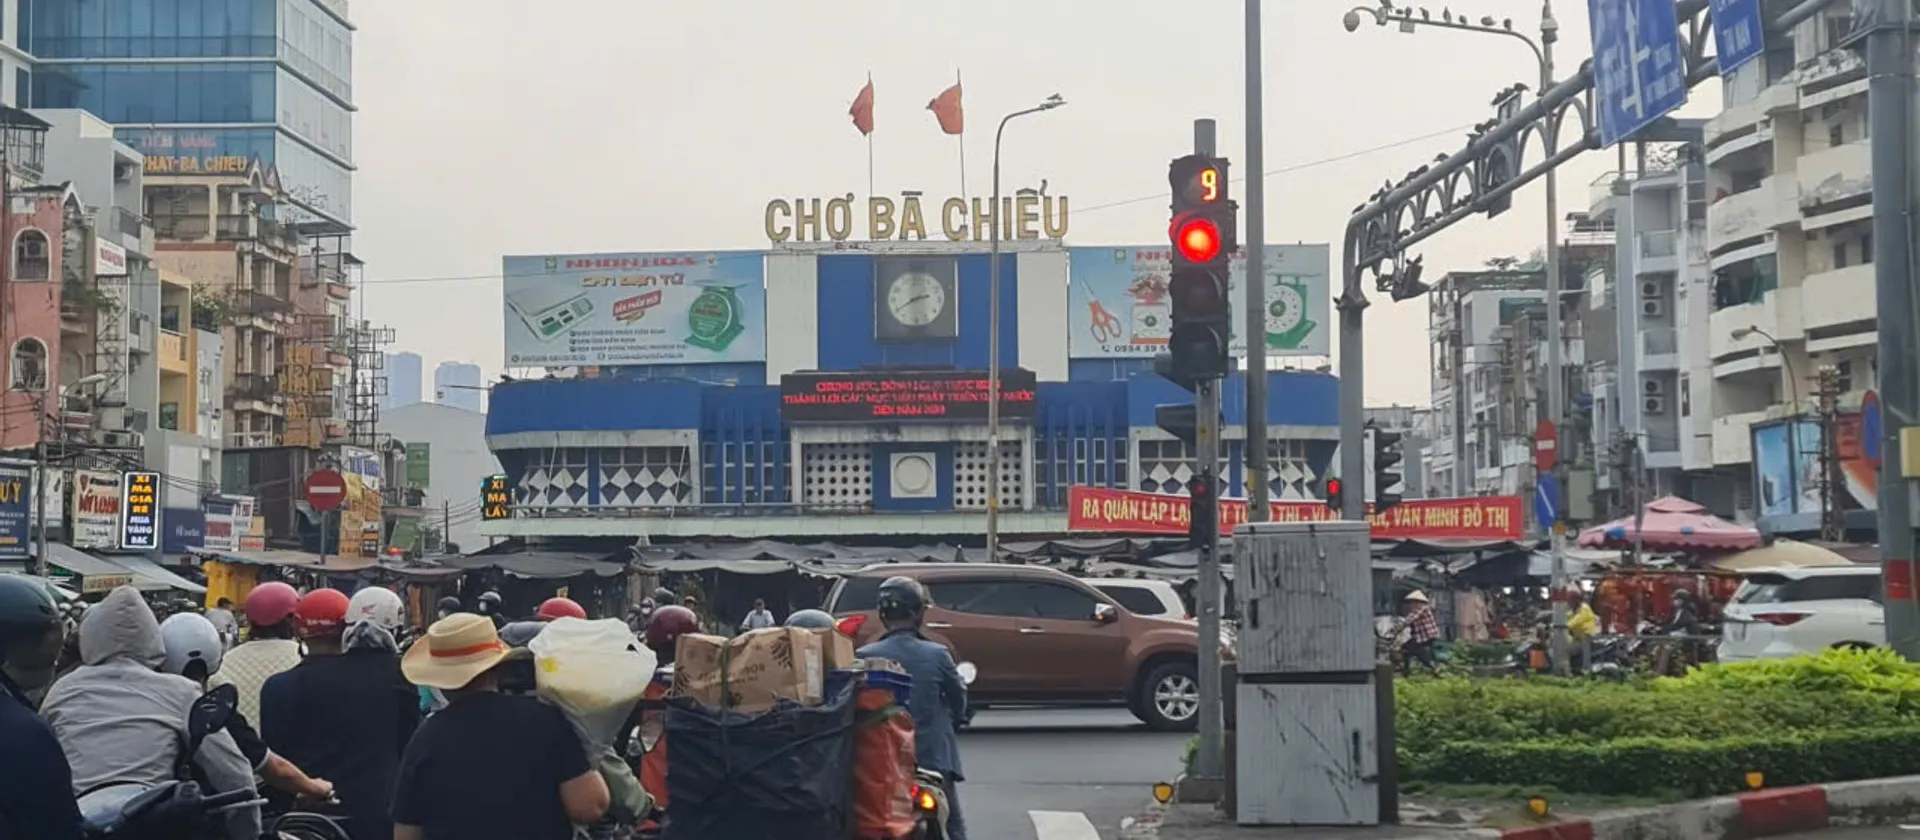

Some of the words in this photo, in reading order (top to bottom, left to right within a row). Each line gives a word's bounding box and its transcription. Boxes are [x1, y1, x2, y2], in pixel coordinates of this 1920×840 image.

[1200, 168, 1218, 202] 9
[491, 480, 504, 489] XI
[1083, 498, 1099, 519] RA
[1104, 495, 1138, 524] QUÂN
[1142, 497, 1167, 525] LẬP
[1394, 504, 1422, 527] VĂN
[1425, 507, 1459, 527] MINH
[1486, 506, 1510, 533] THỊ
